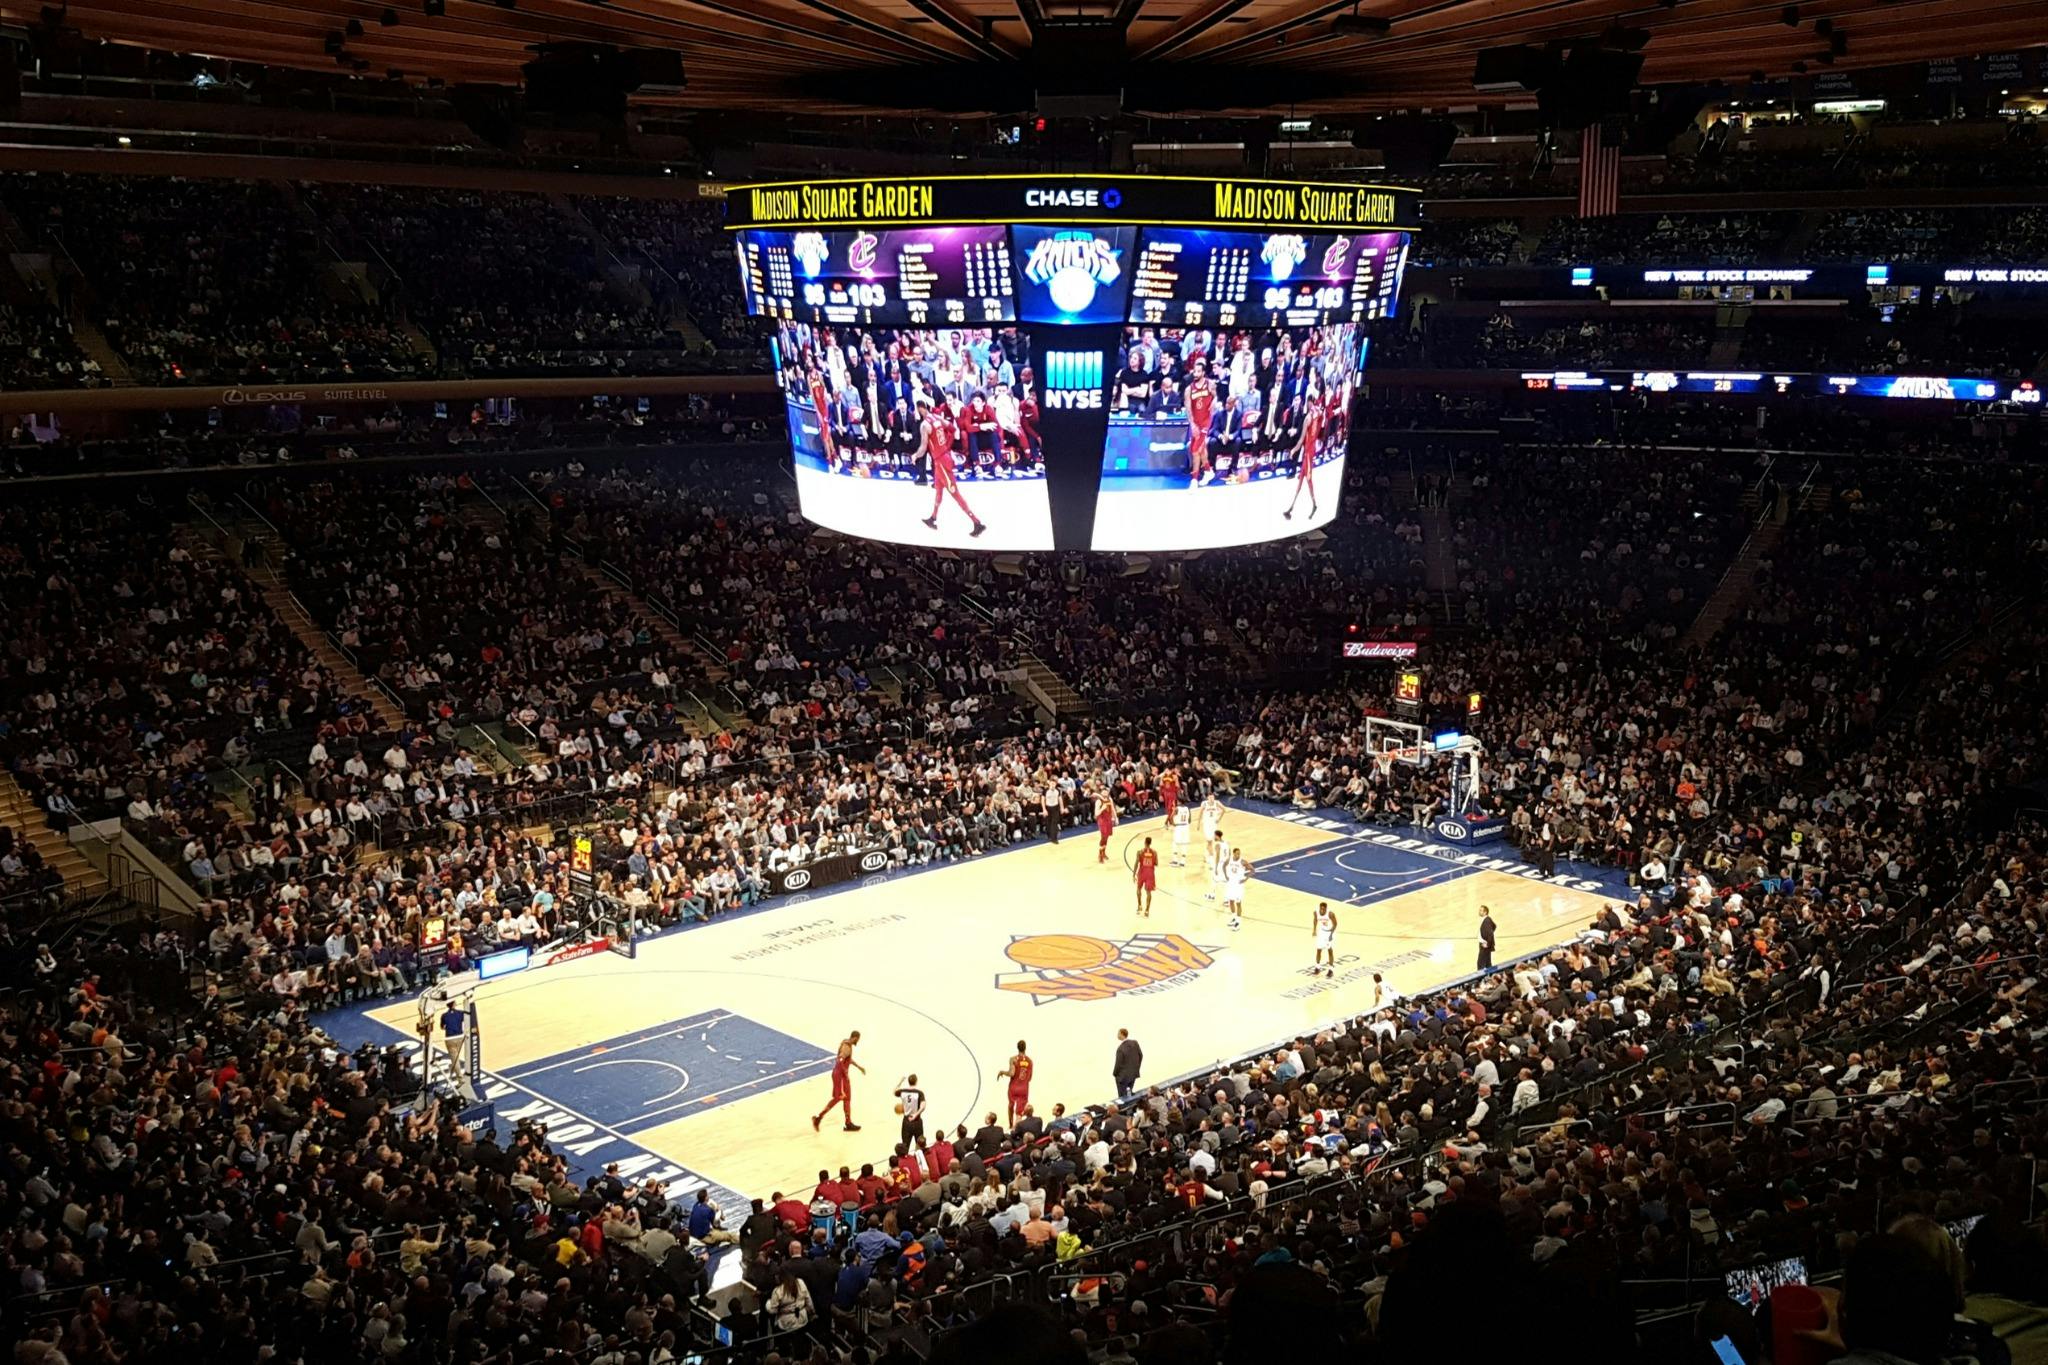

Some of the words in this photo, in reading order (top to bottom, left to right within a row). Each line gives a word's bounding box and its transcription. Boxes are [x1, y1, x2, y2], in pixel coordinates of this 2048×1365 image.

[752, 187, 799, 221] MADISON
[802, 184, 857, 222] SQUARE
[862, 182, 933, 218] GARDEN
[1025, 189, 1099, 207] CHASE
[1215, 183, 1296, 220] MADISON
[1300, 186, 1354, 224] SQUARE
[1356, 188, 1396, 224] GARDEN
[1025, 238, 1121, 286] KNICKS
[1645, 271, 1673, 281] NEW
[1673, 271, 1706, 281] YORK
[1706, 270, 1746, 281] STOCK
[1944, 270, 1976, 281] NEW
[1975, 270, 2008, 281] YORK
[849, 284, 886, 307] 103
[1145, 311, 1162, 323] 32
[245, 391, 307, 402] LEXUS
[324, 390, 356, 401] SUITE
[356, 389, 388, 400] LEVEL
[1045, 388, 1103, 410] NYSE
[1344, 642, 1416, 658] Budweiser
[1399, 683, 1417, 698] 24
[573, 849, 590, 870] 24
[1274, 811, 1348, 830] NEW
[1352, 828, 1449, 856] YORK
[1454, 853, 1604, 891] KNICKS
[762, 918, 834, 940] CHASE
